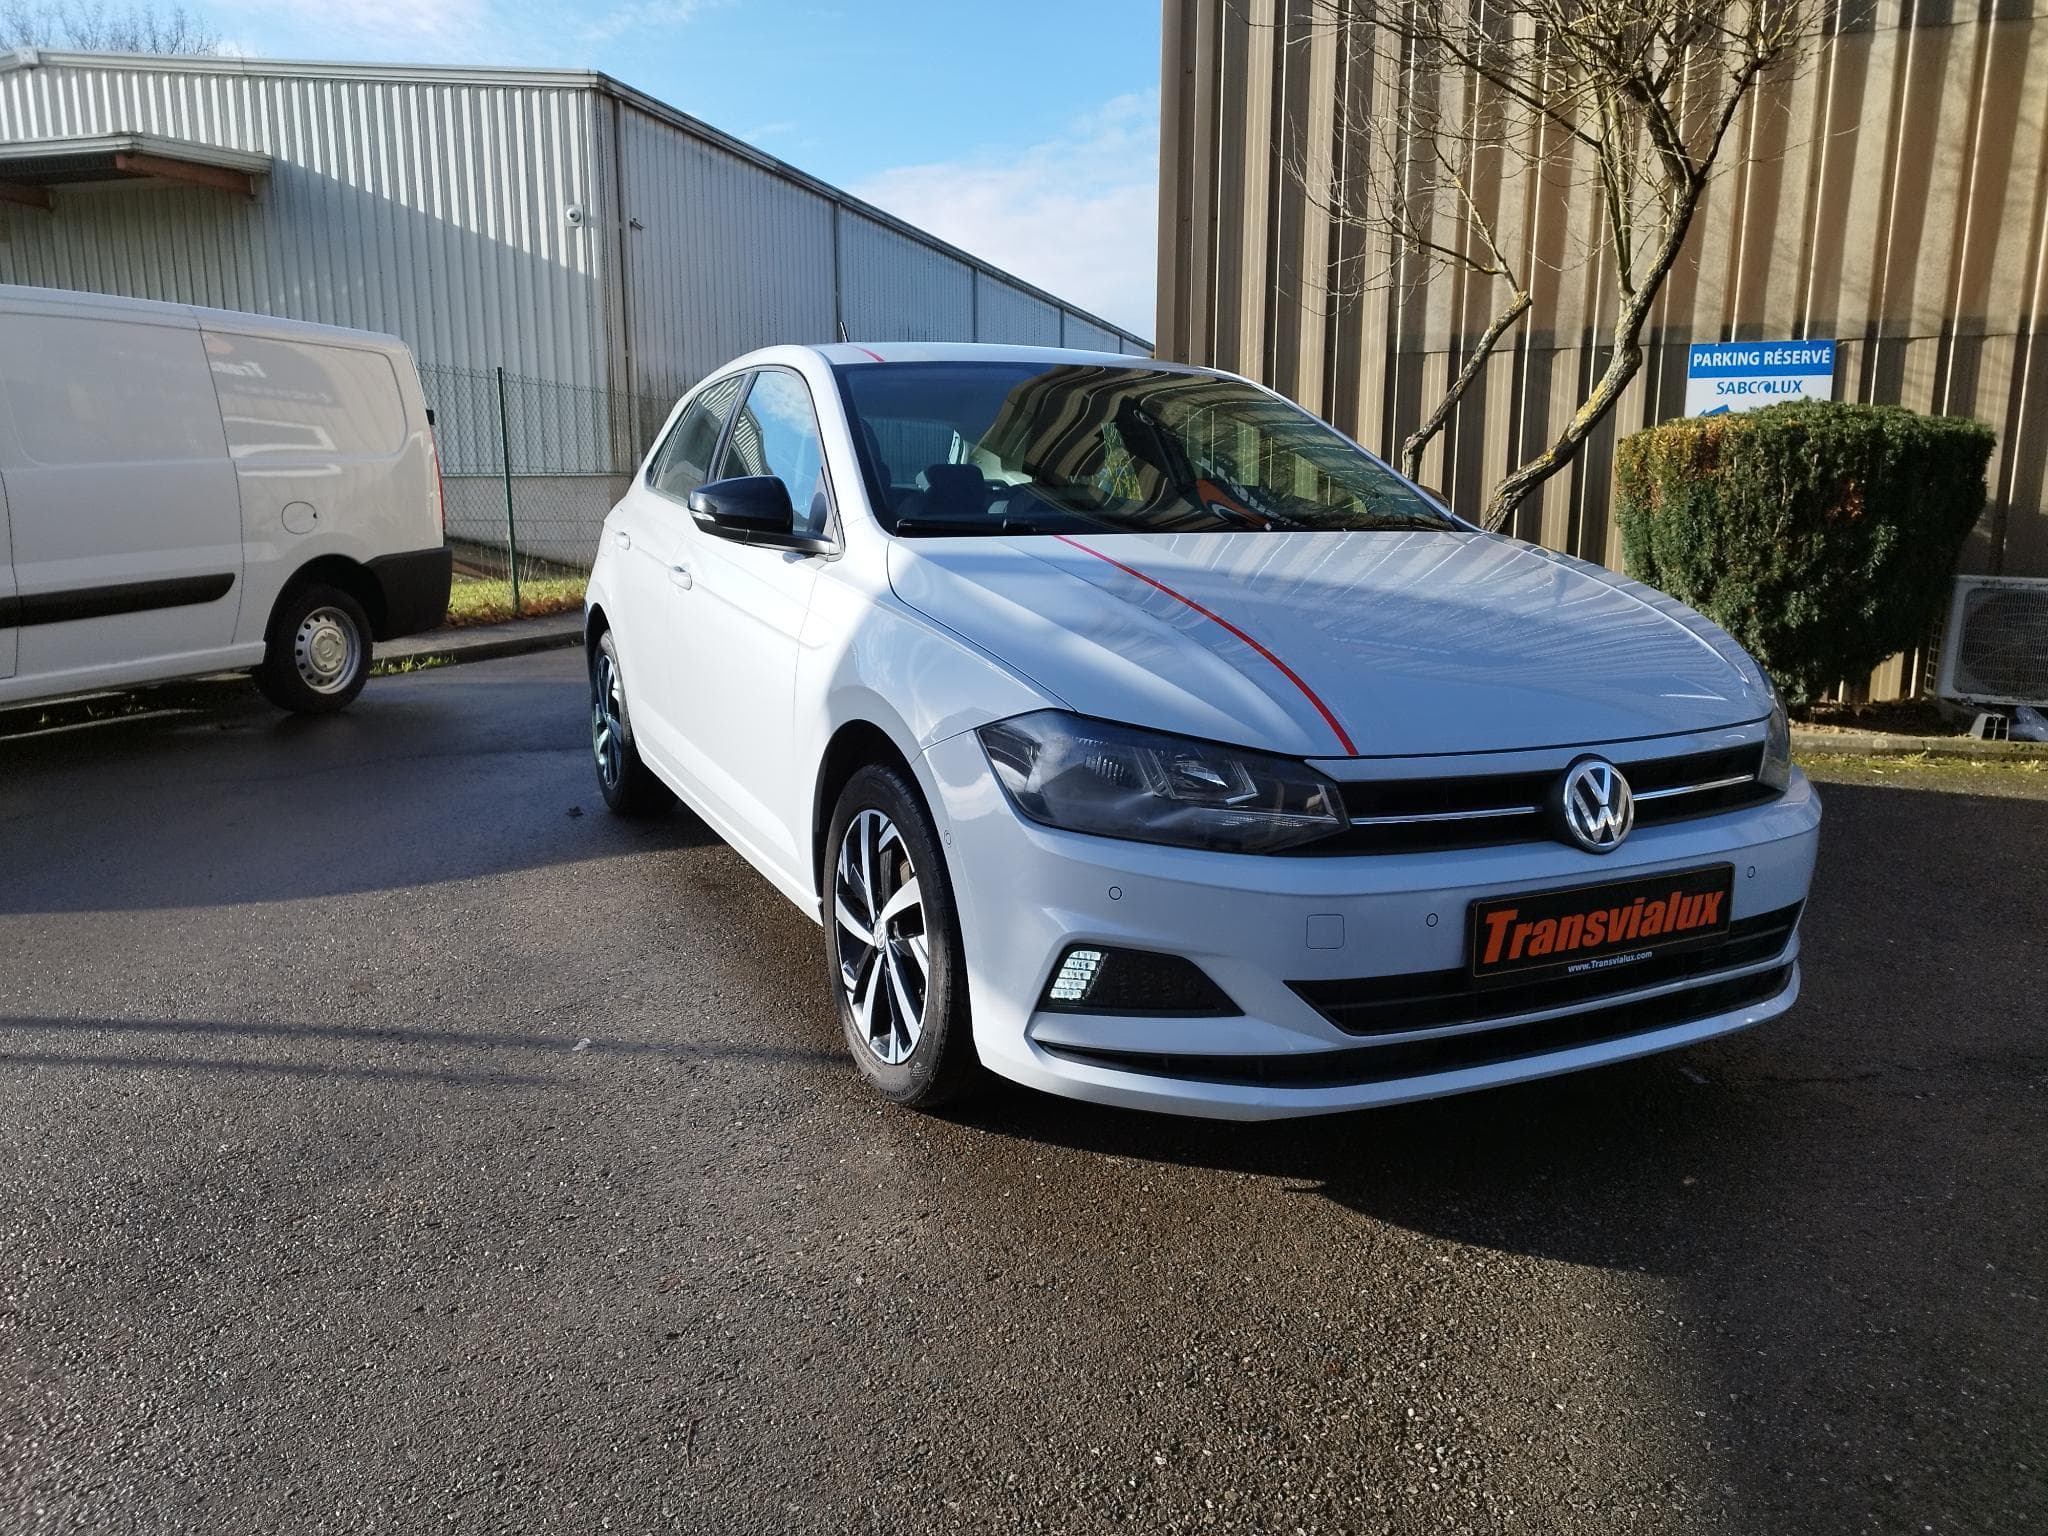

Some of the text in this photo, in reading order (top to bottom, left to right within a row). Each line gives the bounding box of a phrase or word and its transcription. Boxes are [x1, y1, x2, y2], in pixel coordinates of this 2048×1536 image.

[1693, 347, 1831, 367] PARKING RÉSERVÉ
[1482, 890, 1725, 965] Transvialux
[1567, 950, 1653, 973] www.Transvialux.com
